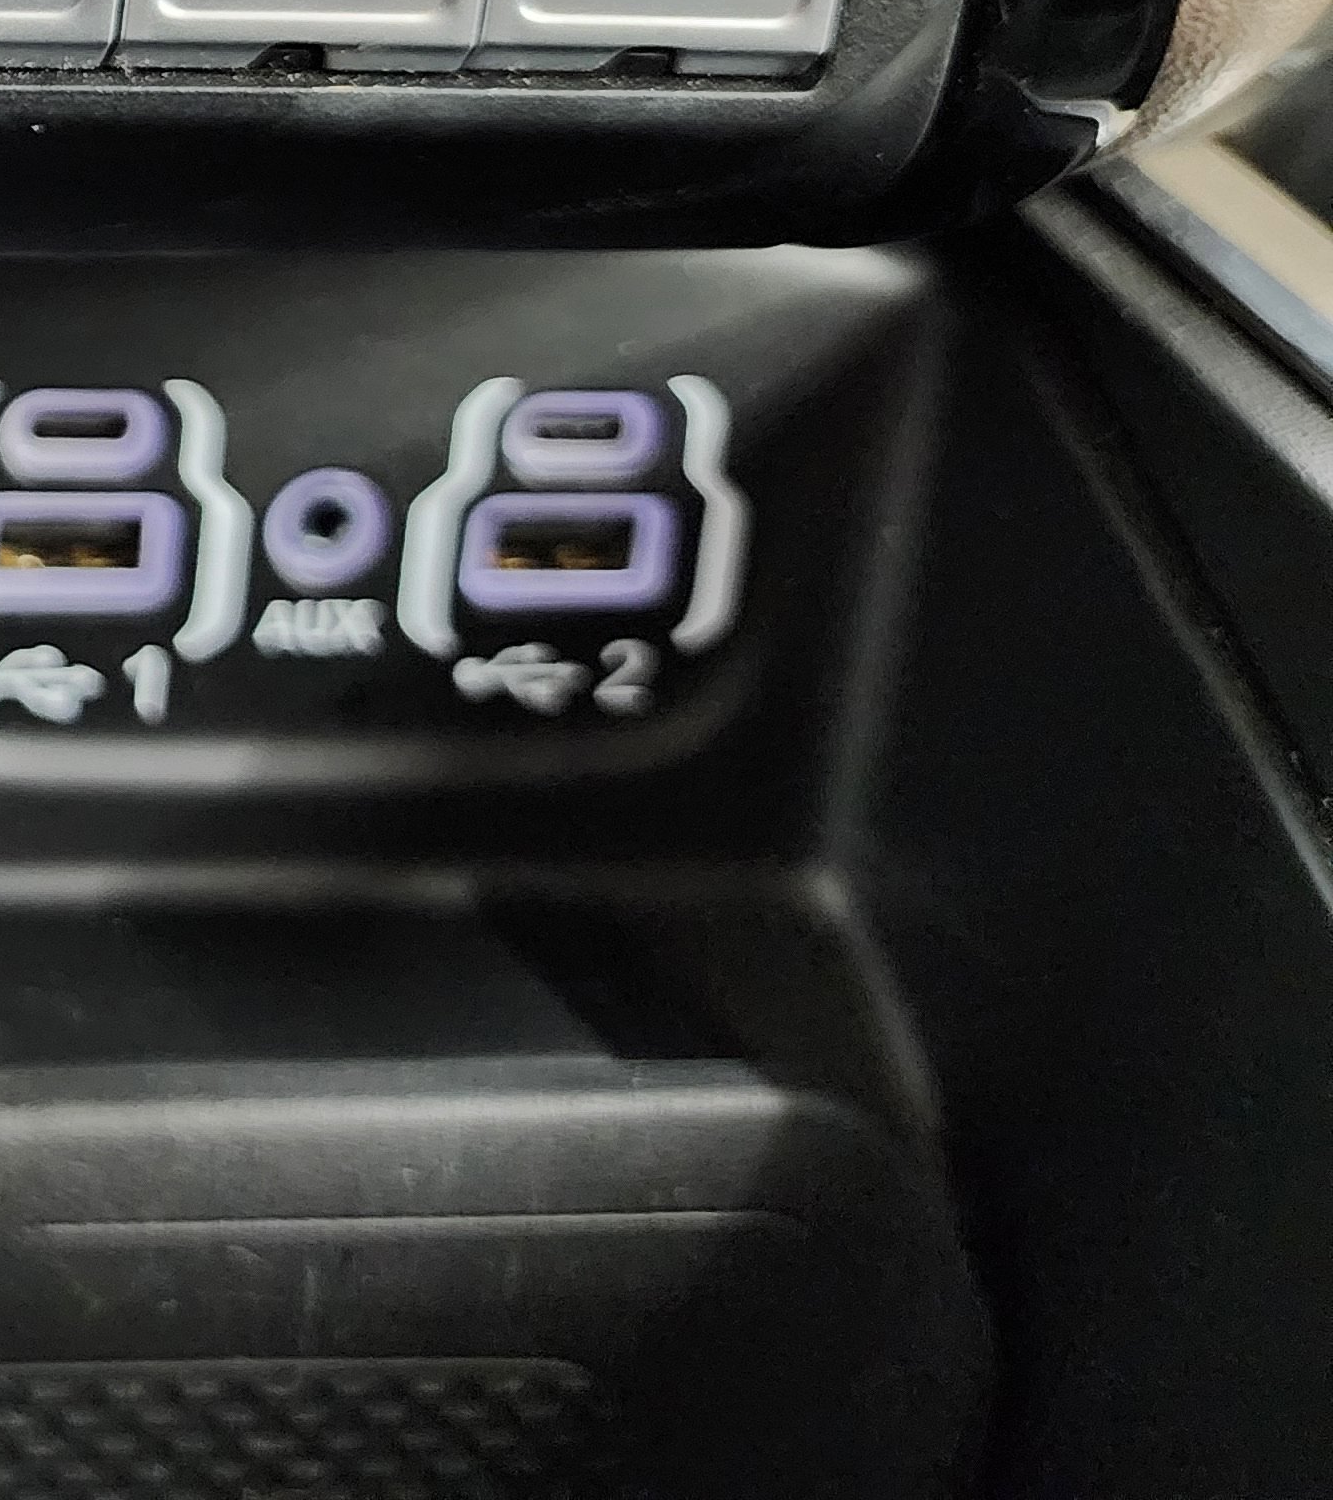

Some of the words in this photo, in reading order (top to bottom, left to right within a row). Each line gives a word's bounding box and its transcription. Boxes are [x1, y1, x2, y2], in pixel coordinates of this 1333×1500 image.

[252, 598, 386, 656] AUX
[123, 643, 172, 723] 1
[593, 637, 661, 714] 2
